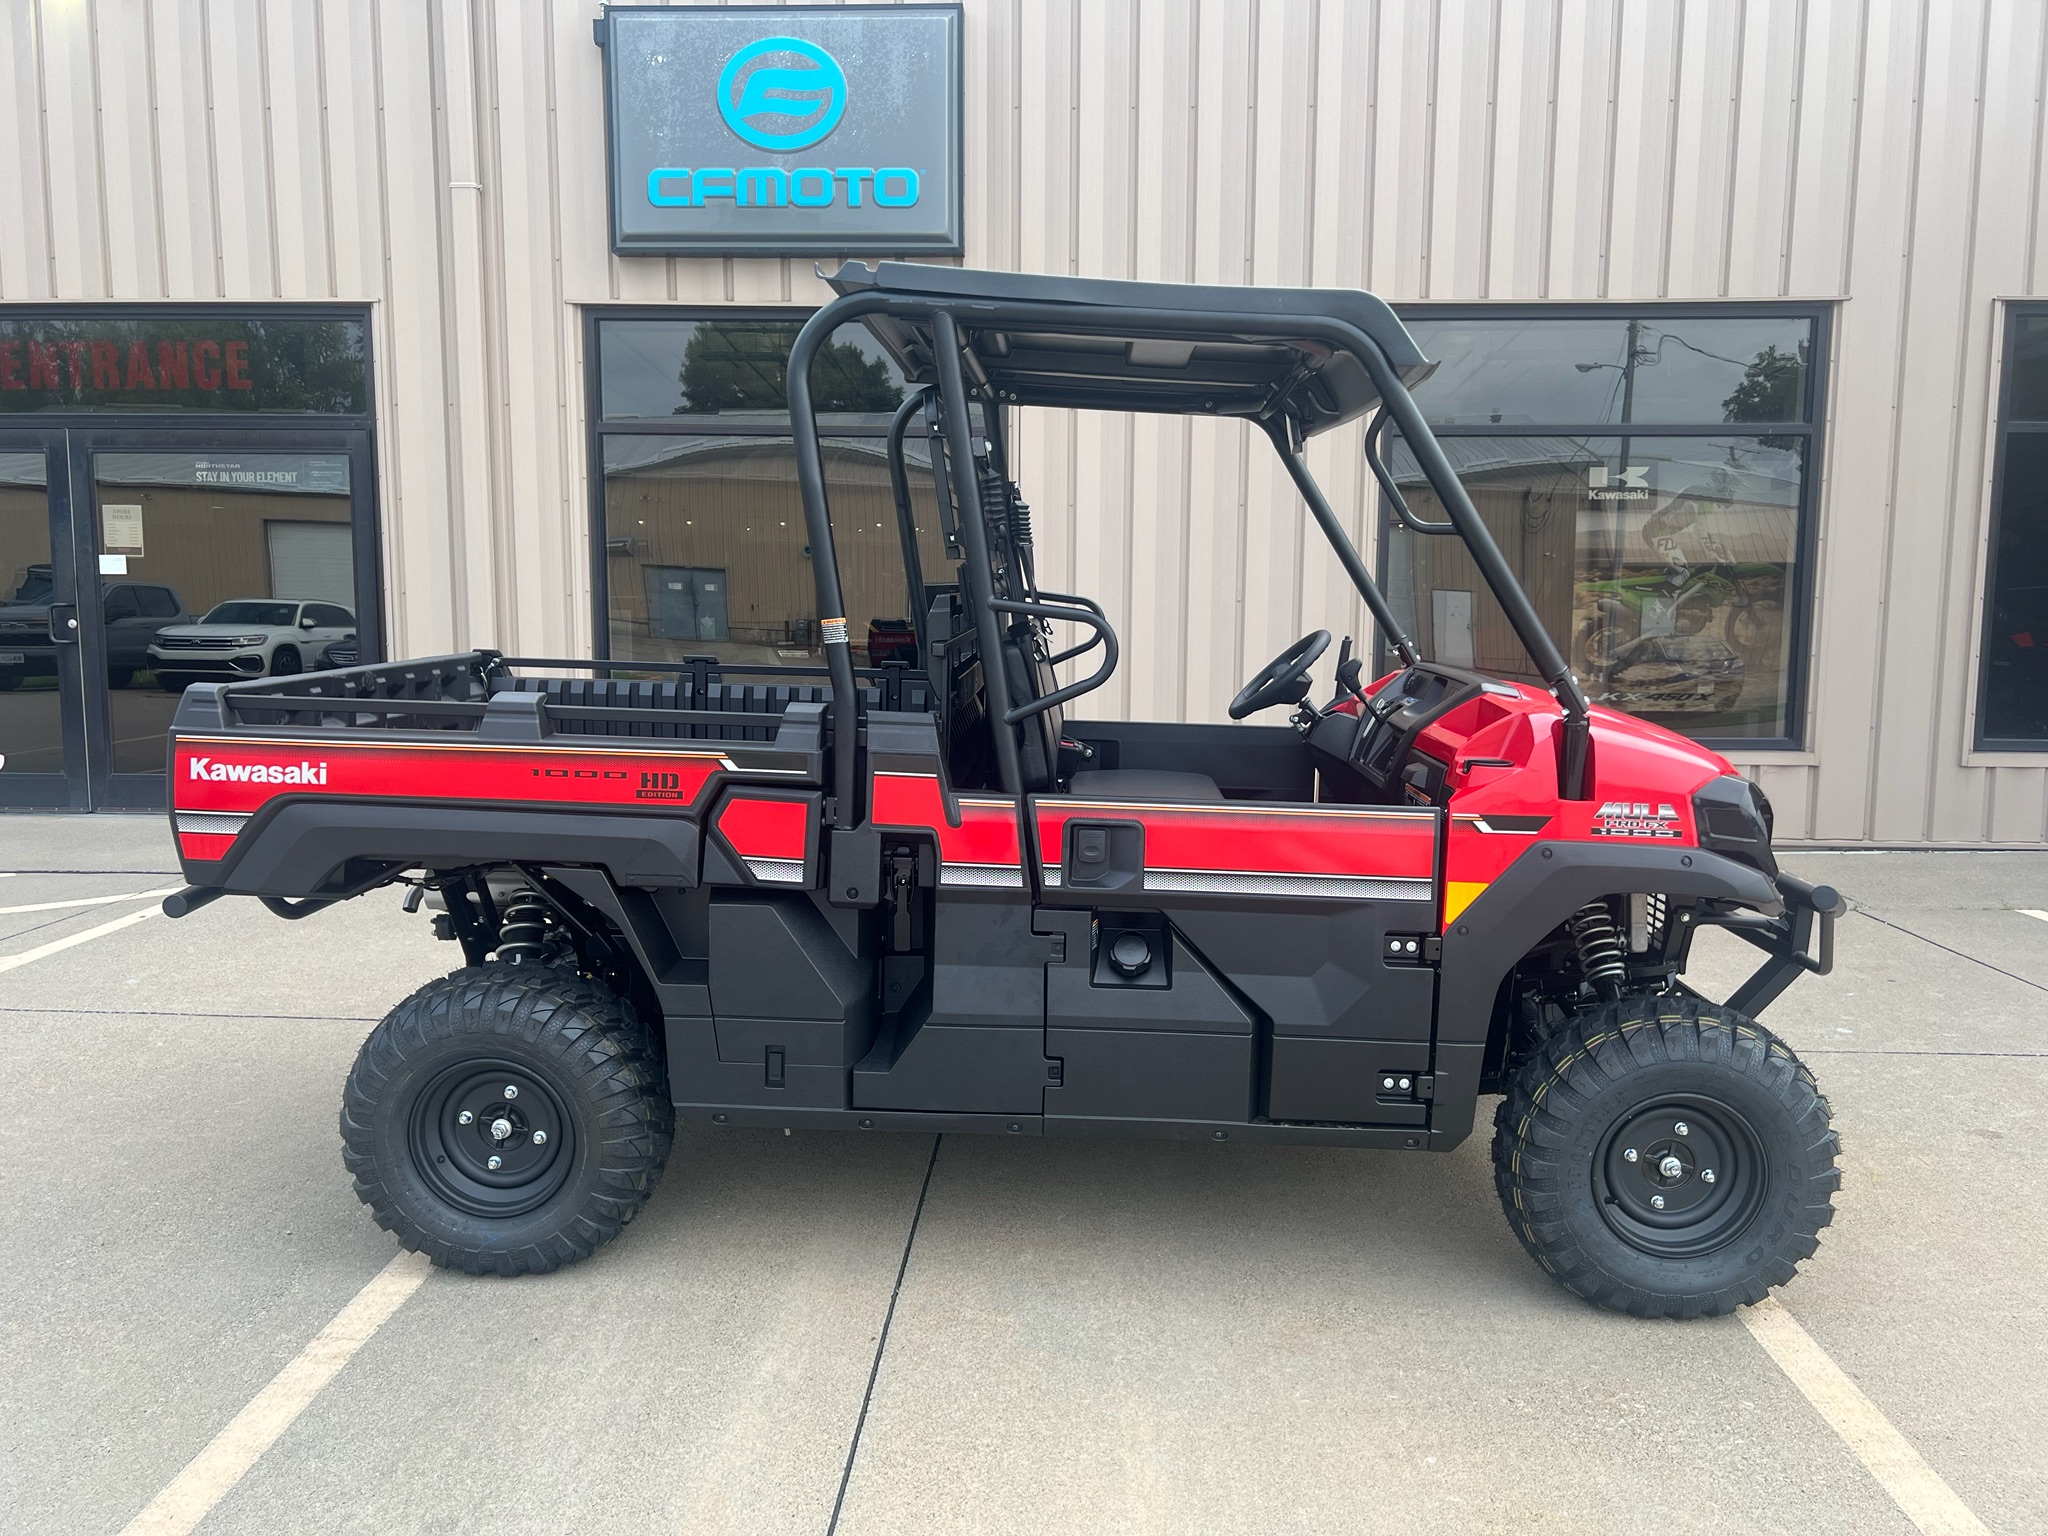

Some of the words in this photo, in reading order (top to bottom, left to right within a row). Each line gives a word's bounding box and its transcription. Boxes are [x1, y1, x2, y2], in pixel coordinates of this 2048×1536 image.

[648, 167, 920, 207] CFMOTO
[0, 339, 253, 391] ENTRANCE
[196, 471, 219, 483] STAY
[220, 471, 230, 483] IN
[232, 471, 255, 483] YOUR
[256, 471, 298, 483] ELEMENT
[1588, 489, 1649, 501] Kawasaki
[189, 757, 327, 785] Kawasaki
[531, 768, 628, 779] 1000
[640, 772, 680, 789] HD
[1593, 802, 1681, 821] MULE
[1600, 829, 1674, 837] 1000
[1742, 1160, 1804, 1270] DURO
